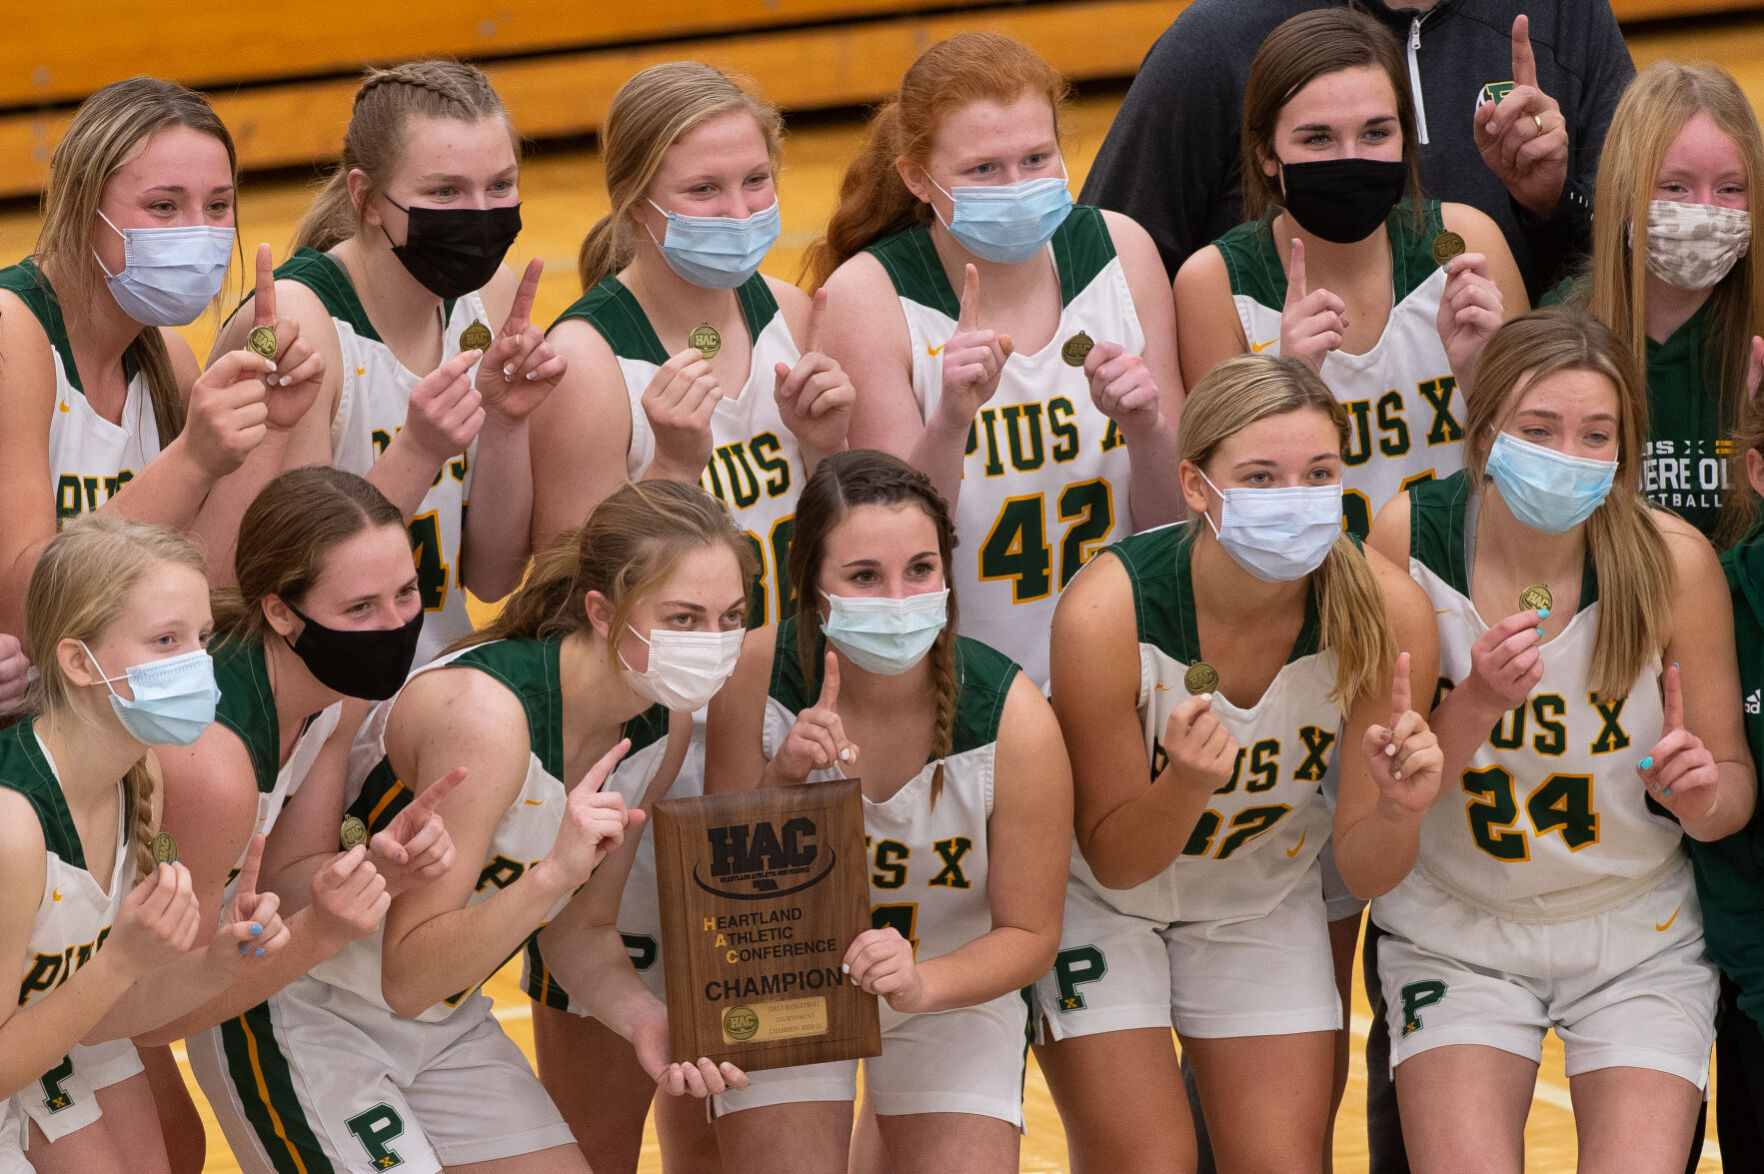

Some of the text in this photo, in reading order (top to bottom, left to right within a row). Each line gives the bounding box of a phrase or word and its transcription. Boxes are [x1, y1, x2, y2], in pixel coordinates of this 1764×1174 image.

[694, 334, 718, 346] HAC
[1416, 375, 1466, 448] X
[699, 431, 792, 511] IUS
[978, 476, 1116, 605] 42
[1588, 687, 1631, 756] X
[1292, 724, 1337, 783] X
[1460, 764, 1600, 863] 24
[707, 817, 818, 878] HAC
[865, 835, 973, 890] S X
[703, 907, 803, 932] HEARTLAND
[715, 926, 793, 948] ATHLETIC
[726, 938, 838, 964] CONFERENCE
[1054, 944, 1109, 1013] P
[705, 966, 844, 1001] CHAMPION
[1400, 979, 1449, 1039] P
[344, 1101, 405, 1173] P
